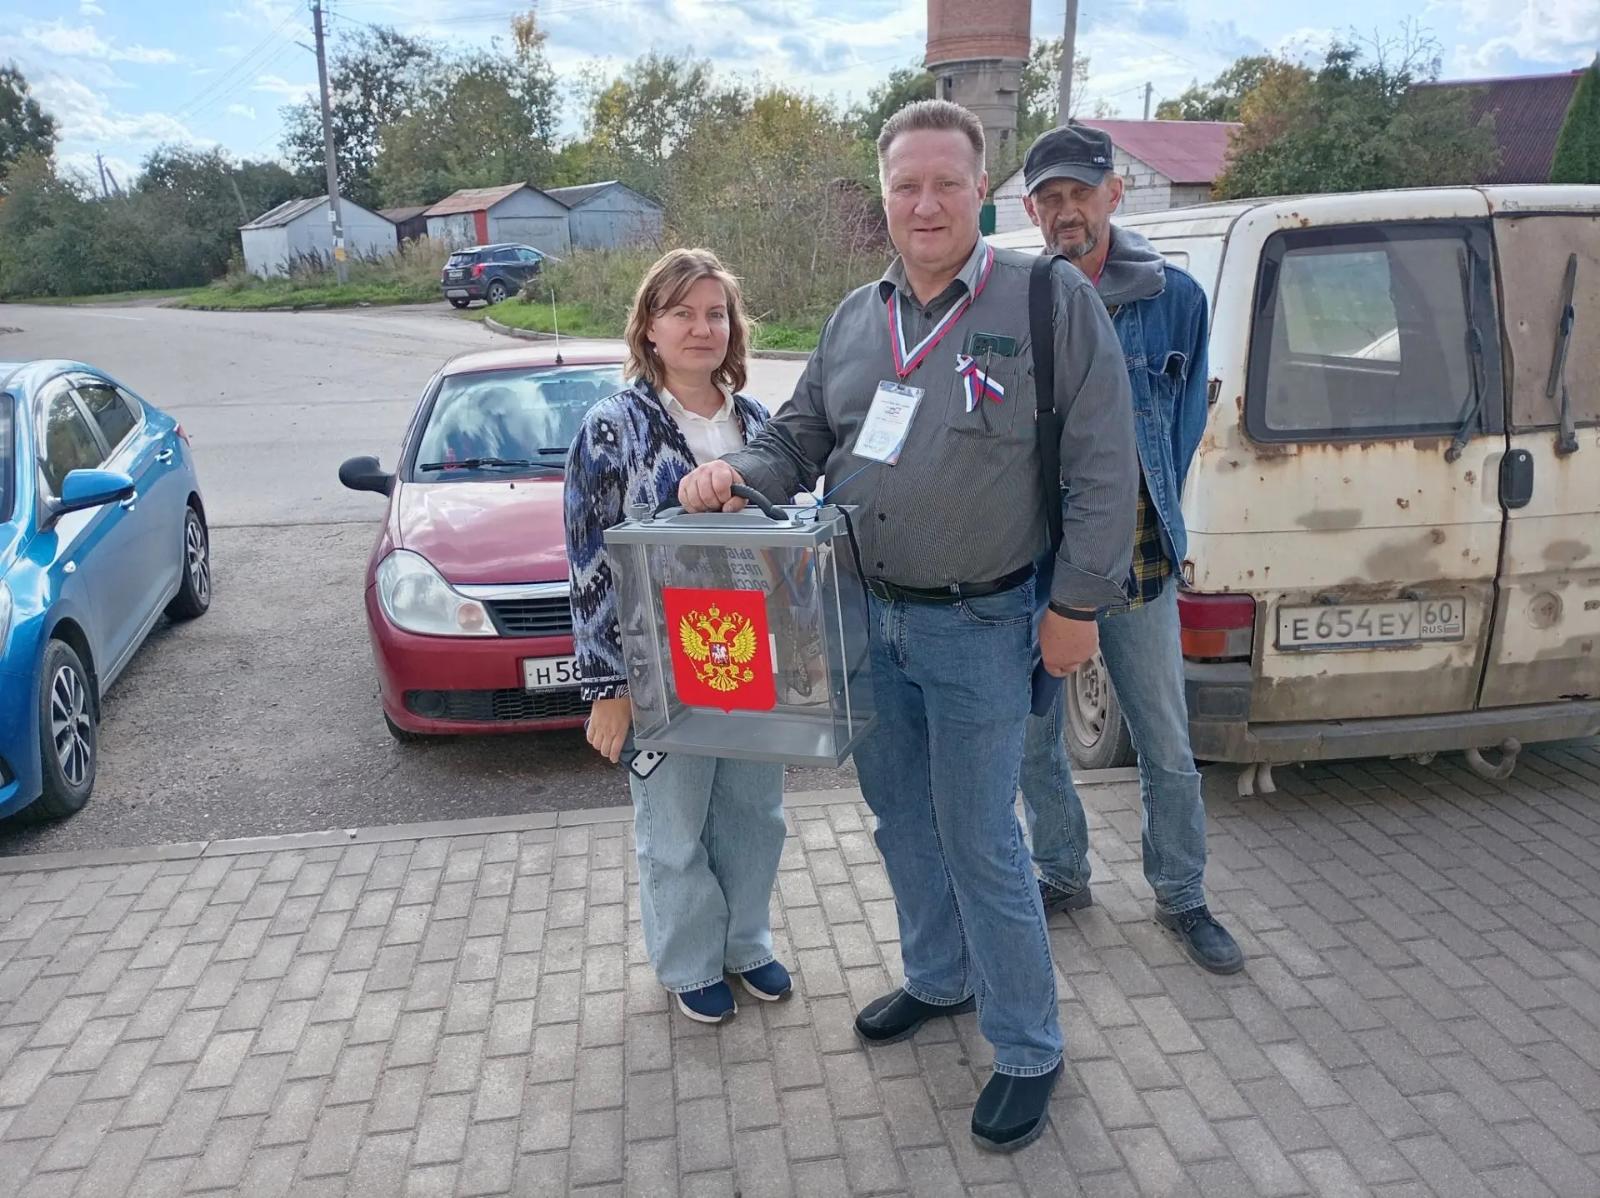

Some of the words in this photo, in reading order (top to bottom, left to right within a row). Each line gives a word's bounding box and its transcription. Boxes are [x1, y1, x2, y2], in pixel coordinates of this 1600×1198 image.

[1424, 603, 1453, 624] 60
[1292, 608, 1414, 641] Е654ЕУ
[1422, 624, 1444, 634] RUS
